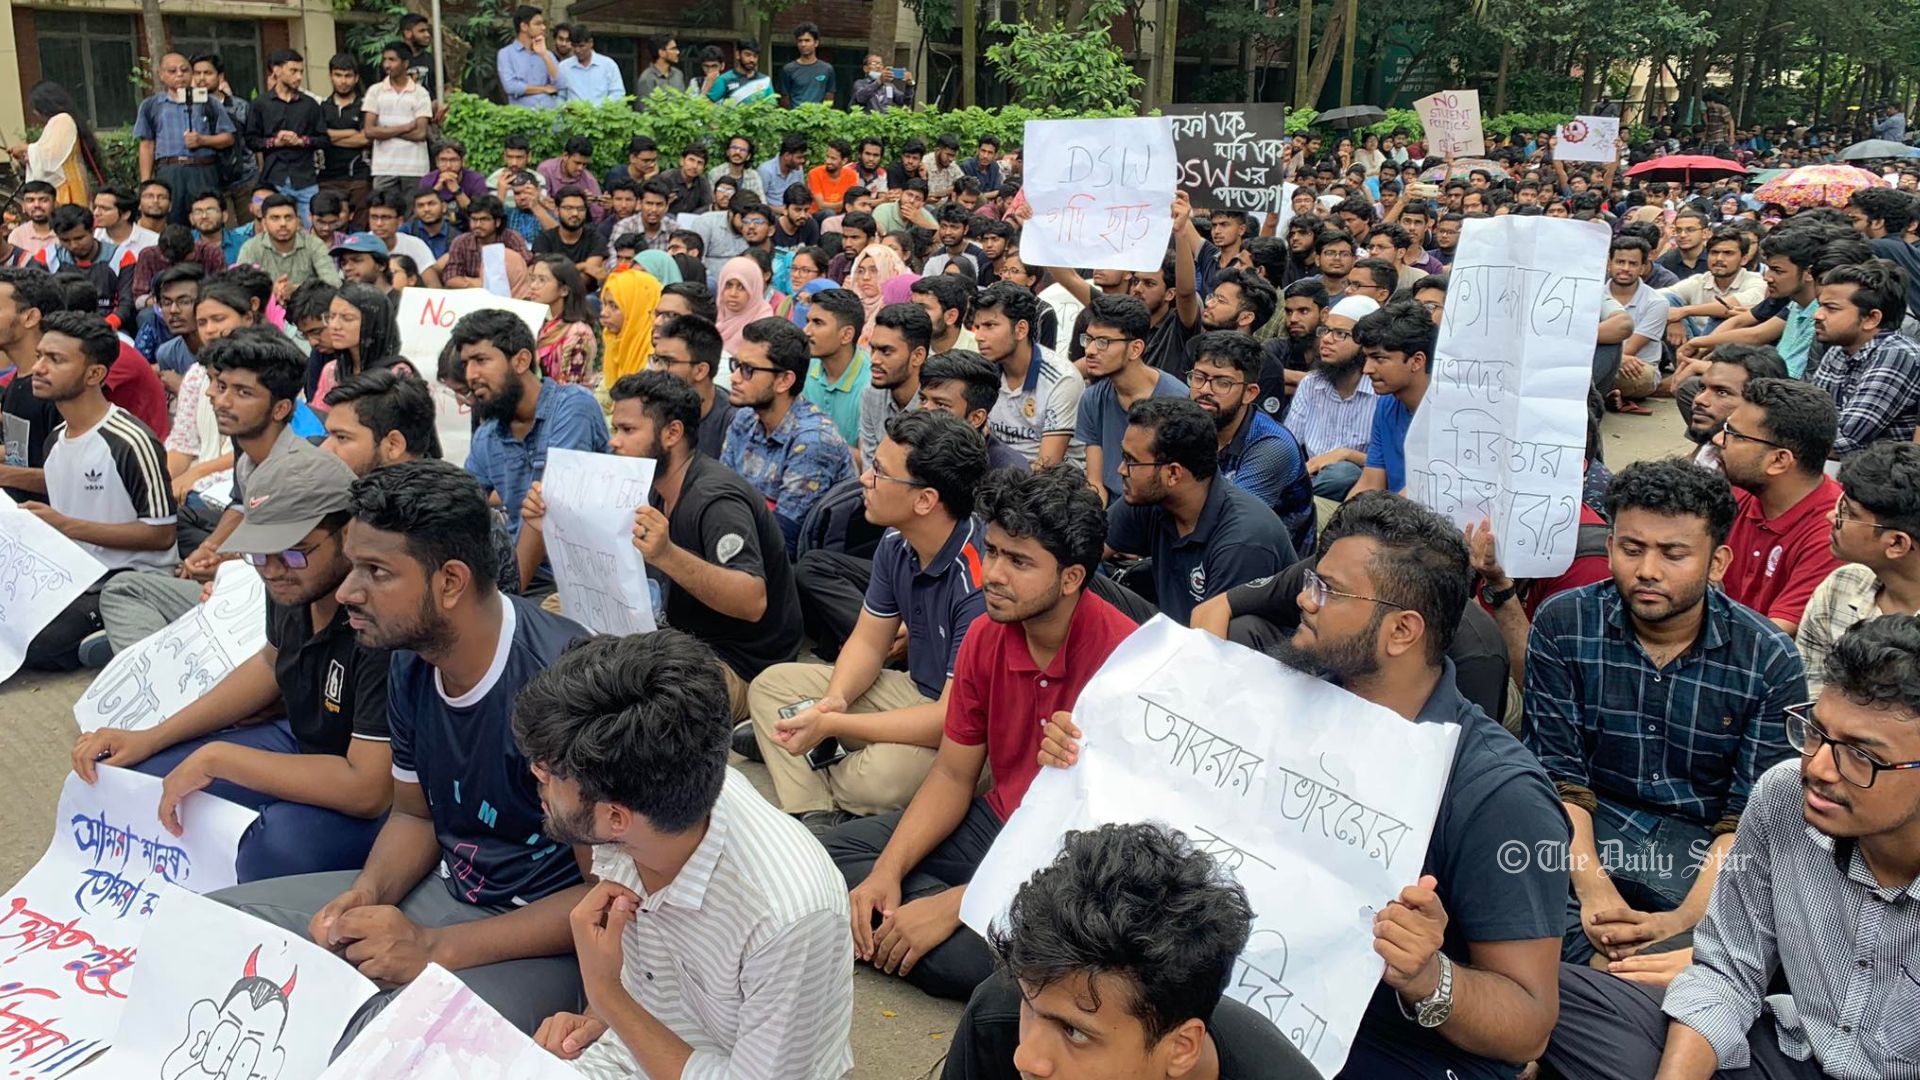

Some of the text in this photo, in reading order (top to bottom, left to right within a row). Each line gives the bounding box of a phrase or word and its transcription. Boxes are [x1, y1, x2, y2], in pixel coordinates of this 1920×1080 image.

[1433, 94, 1458, 109] NO
[1429, 119, 1471, 131] POLITICS
[1213, 132, 1284, 166] দাবি এক
[1438, 140, 1472, 152] BET
[1058, 145, 1151, 188] DSW
[1177, 159, 1270, 187] DSW এর
[420, 297, 456, 328] No
[1138, 695, 1264, 796] আবরার
[1279, 752, 1413, 870] ভাইয়ের
[72, 810, 139, 868] আমরা
[75, 868, 146, 920] তোমরা
